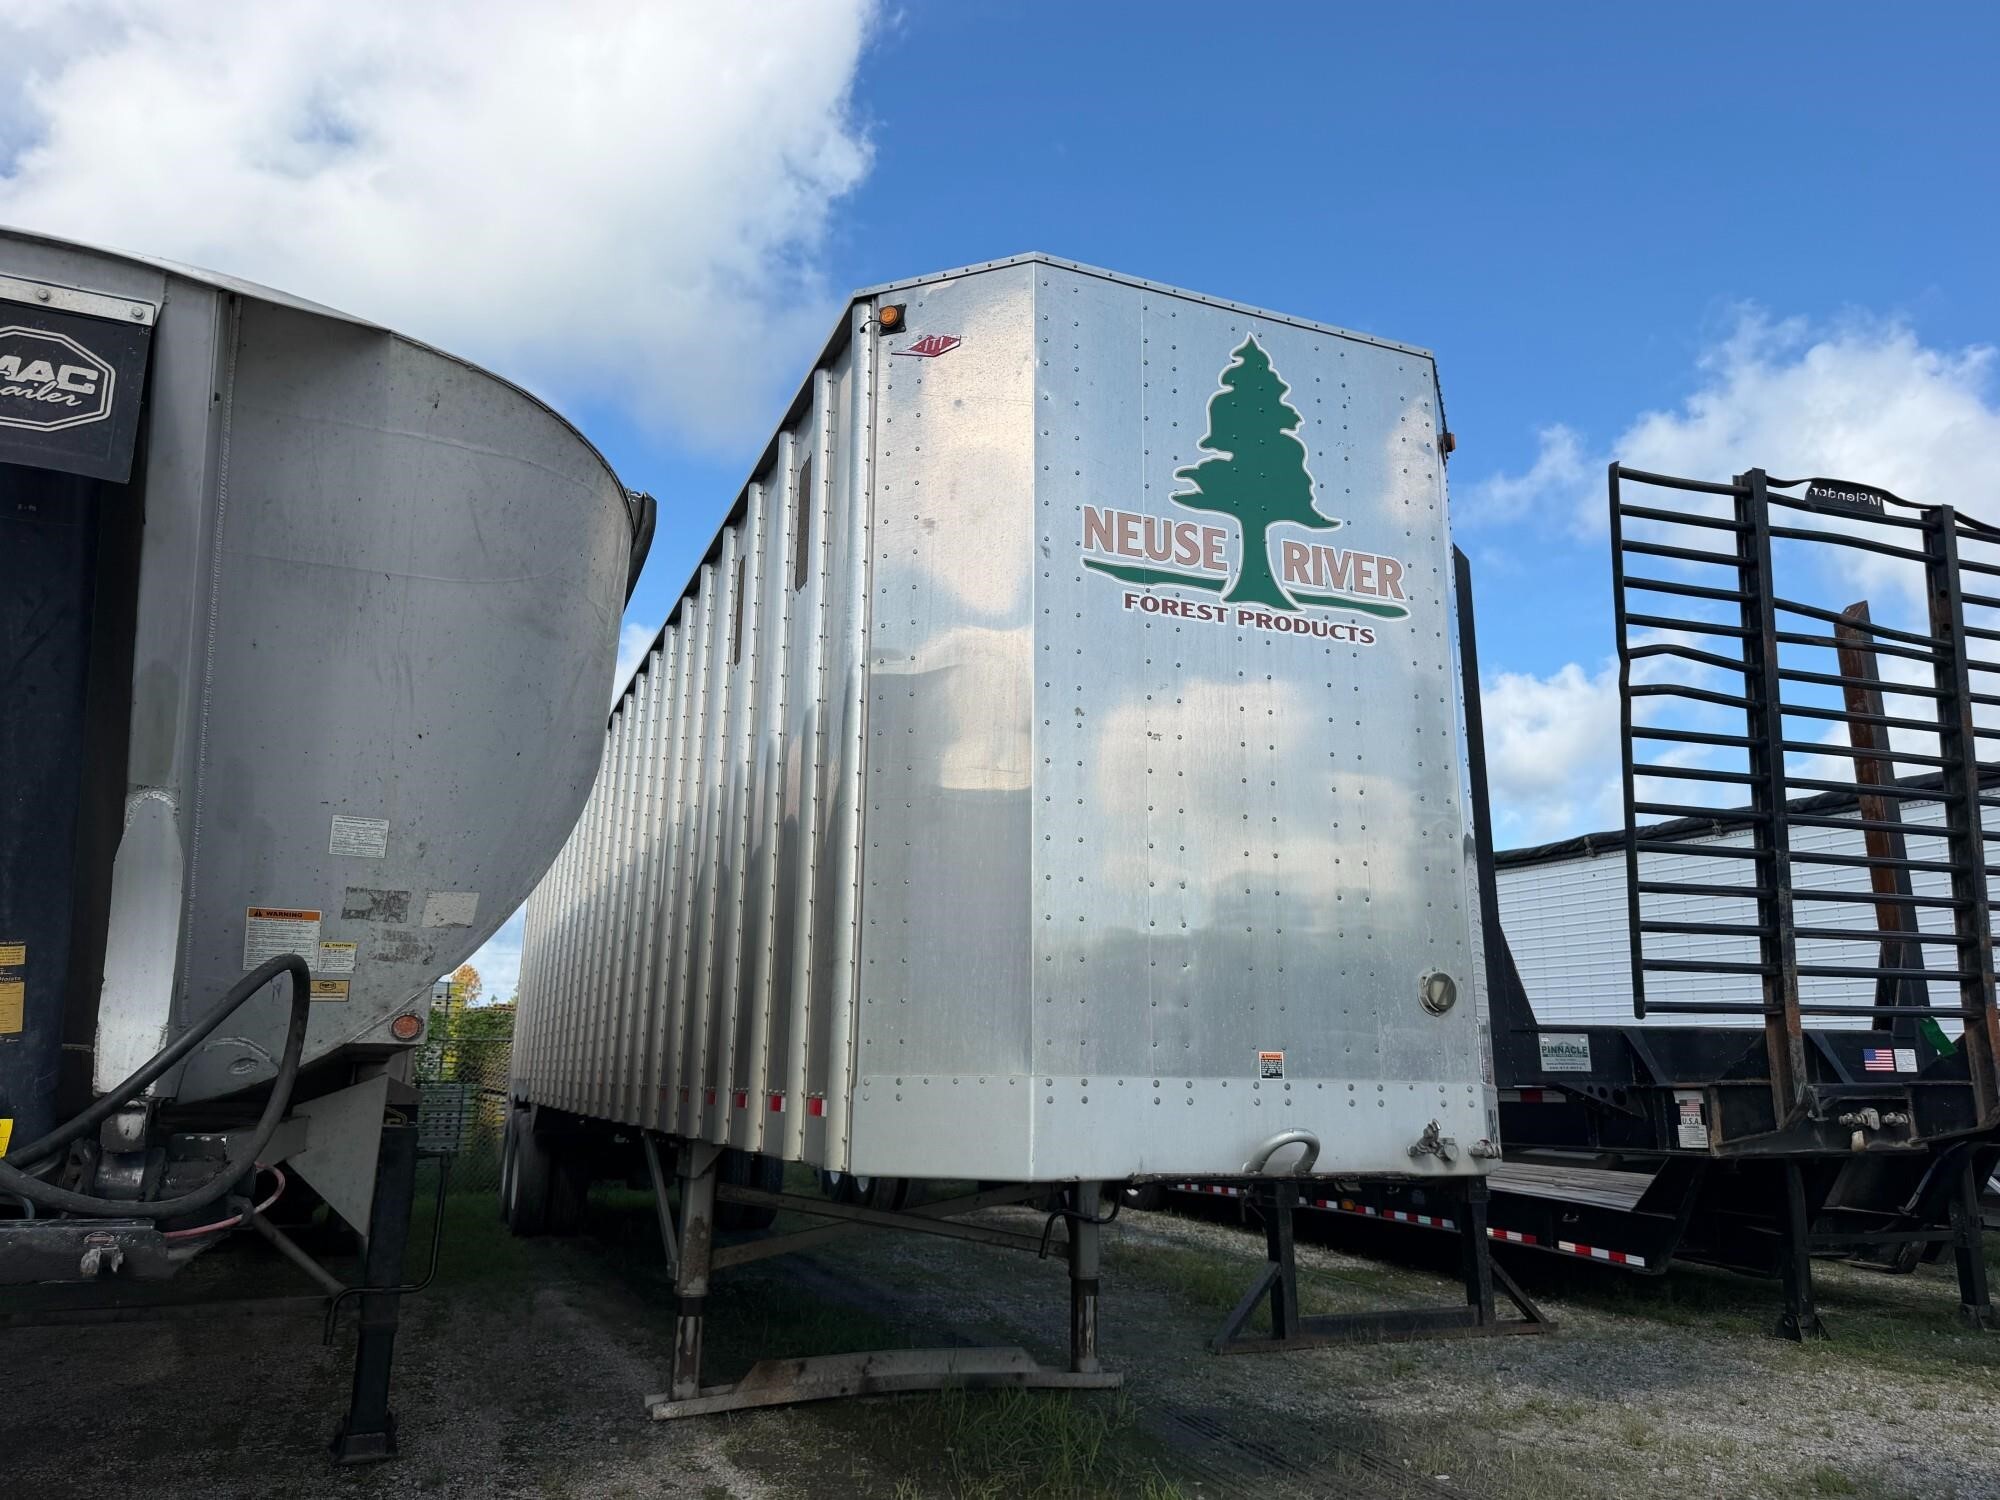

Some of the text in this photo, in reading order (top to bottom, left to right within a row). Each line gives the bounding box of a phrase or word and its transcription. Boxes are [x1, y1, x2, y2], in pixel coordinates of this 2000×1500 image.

[0, 379, 82, 407] ailer
[1082, 505, 1405, 600] NEUSE RIVER
[1123, 593, 1376, 645] FOREST PRODUCTS
[1541, 1046, 1588, 1056] PINNACLE
